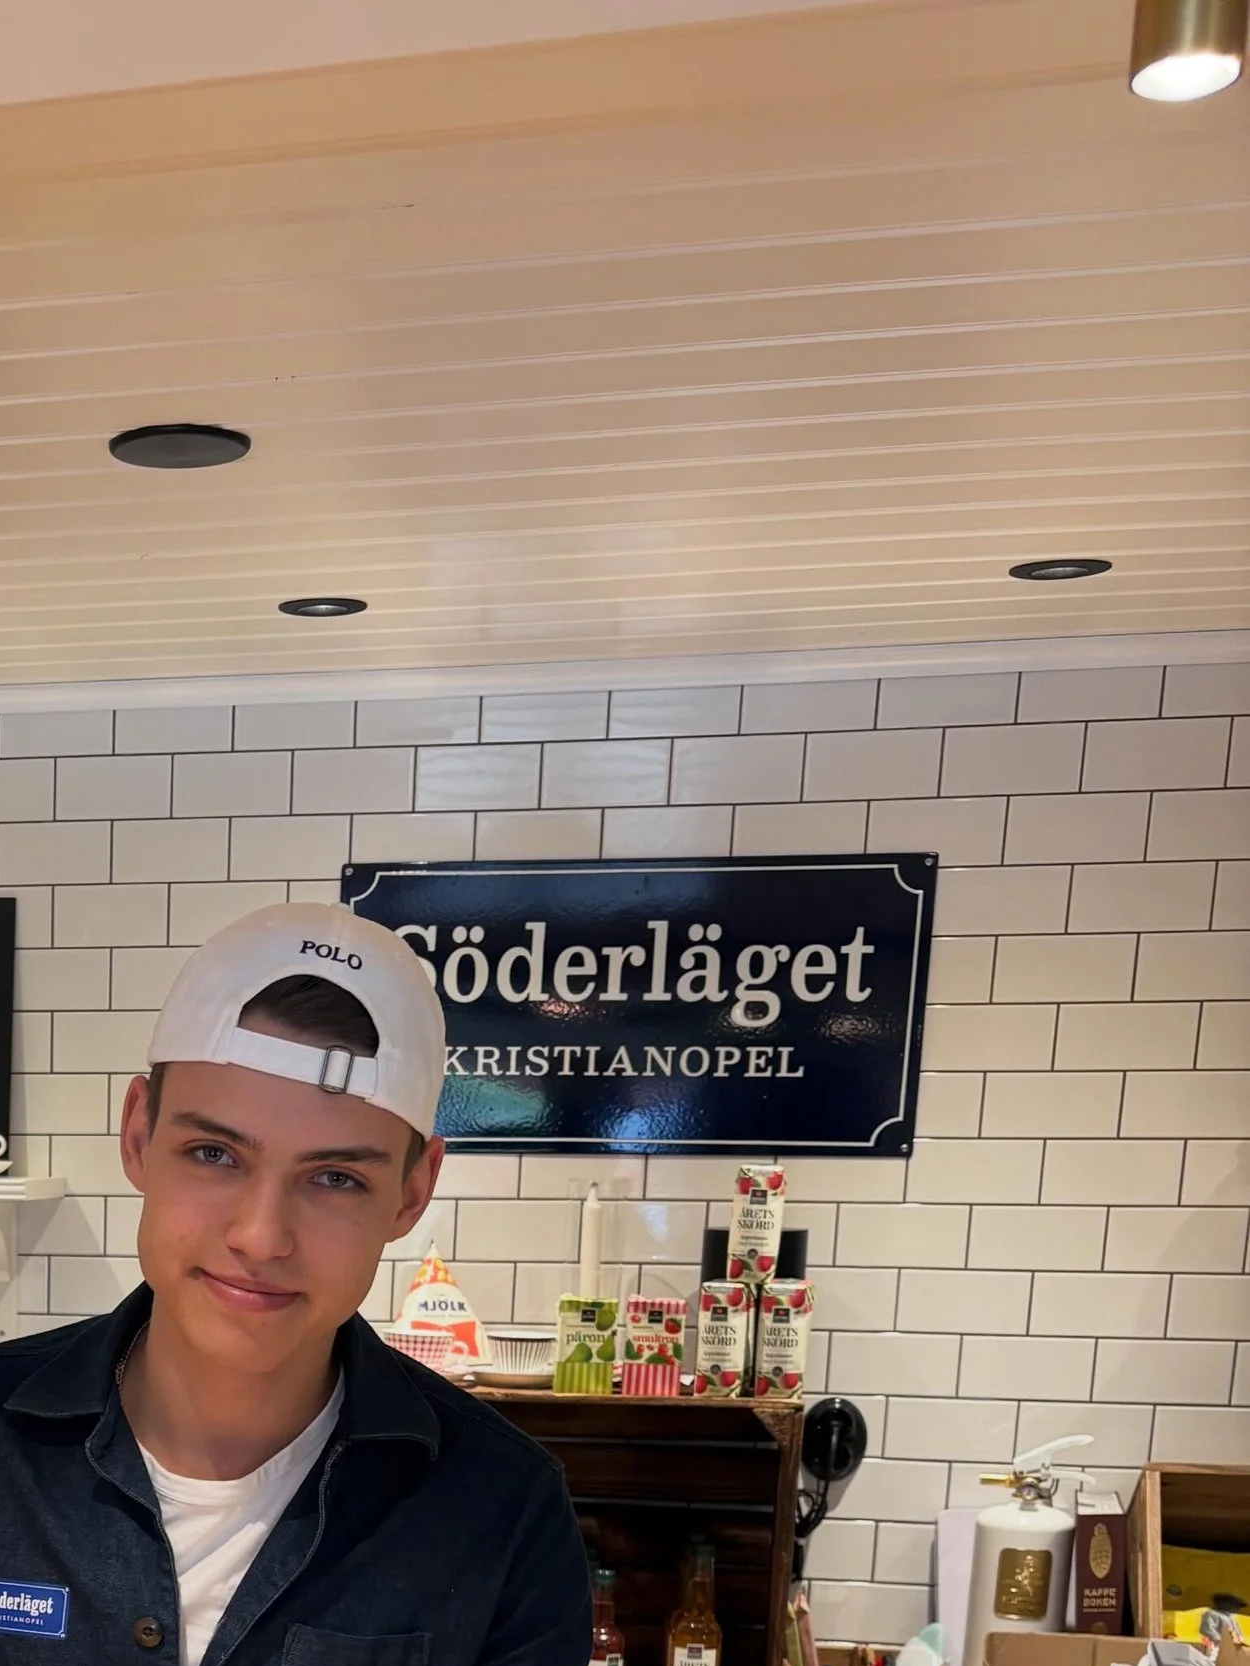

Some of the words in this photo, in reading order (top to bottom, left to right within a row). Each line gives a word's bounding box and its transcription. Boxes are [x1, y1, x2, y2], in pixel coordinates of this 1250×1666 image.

[300, 940, 363, 970] POLO
[391, 920, 875, 1028] Söderläget
[444, 1045, 806, 1079] KRISTIANOPEL
[418, 1298, 468, 1312] MJÖLK
[566, 1330, 606, 1344] päron
